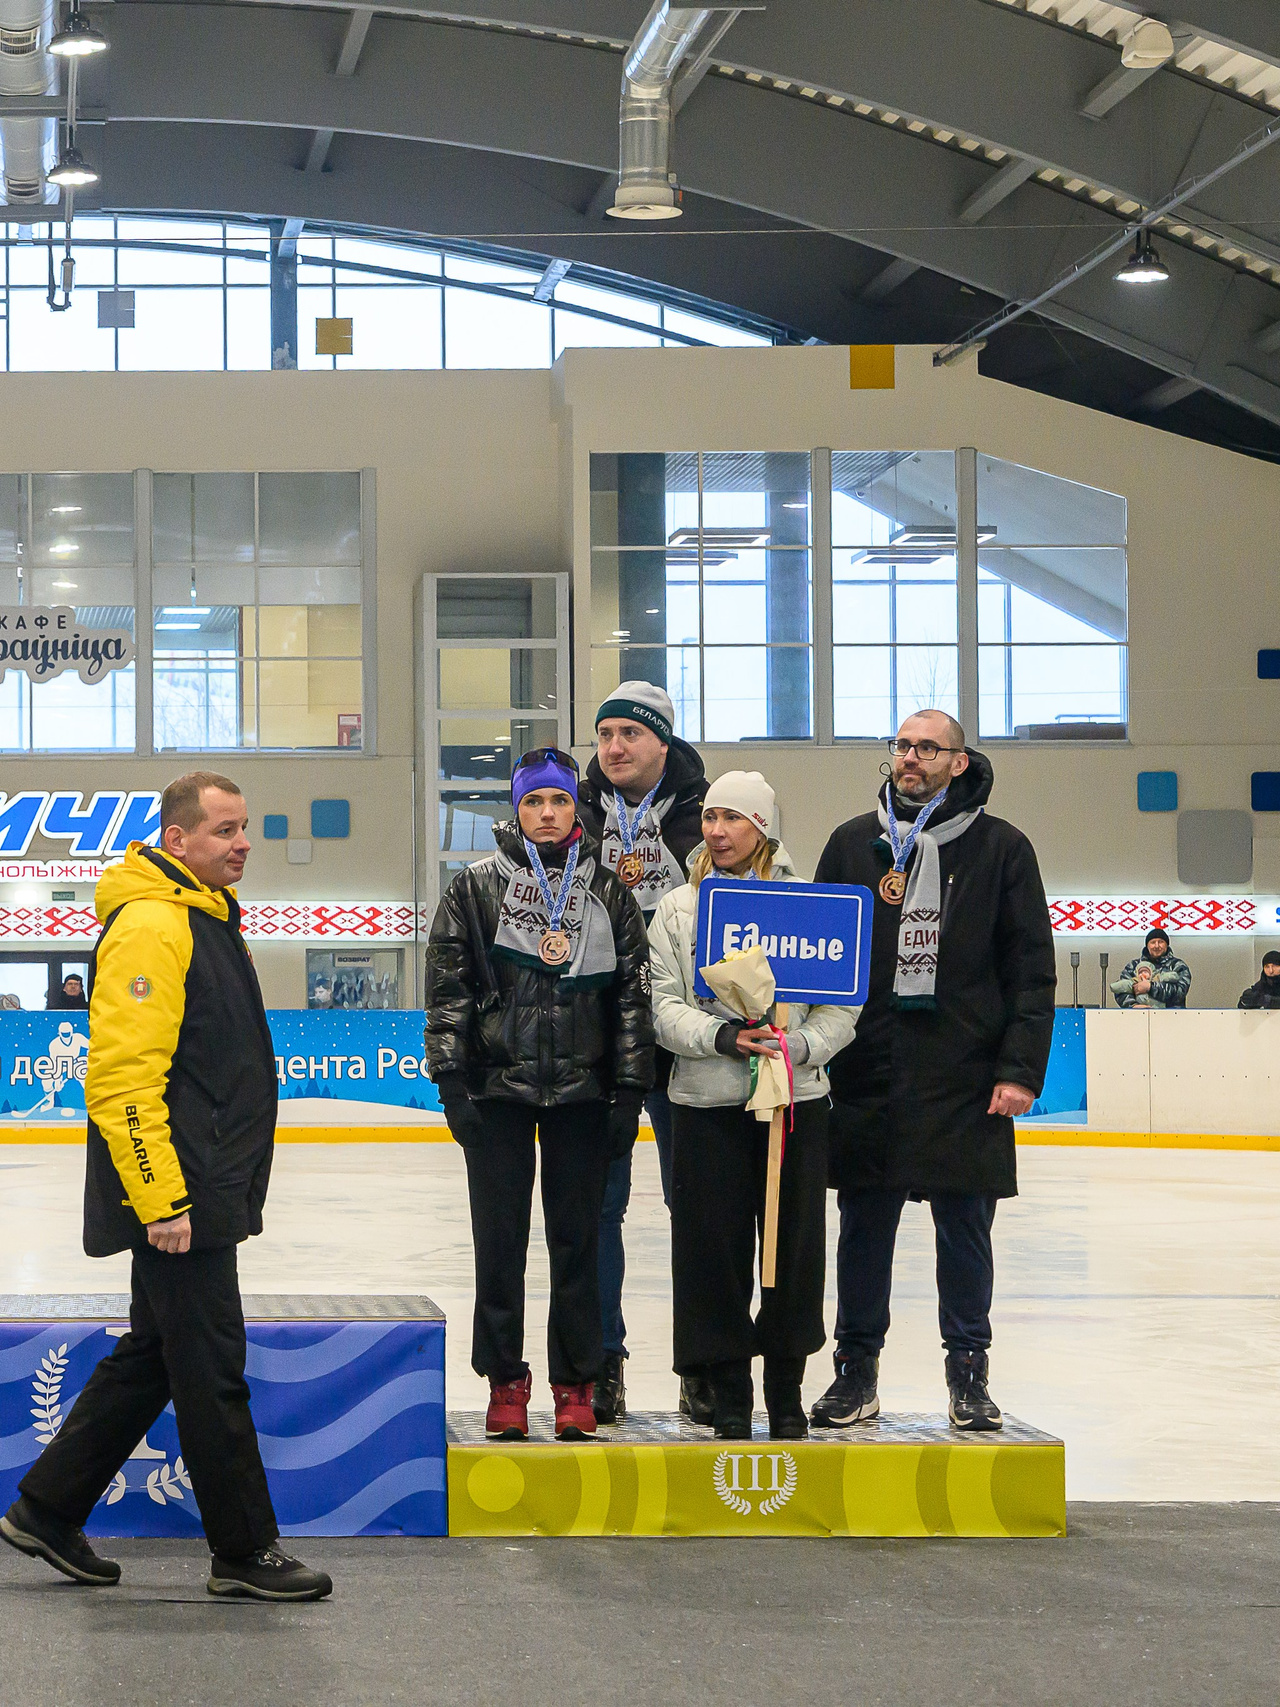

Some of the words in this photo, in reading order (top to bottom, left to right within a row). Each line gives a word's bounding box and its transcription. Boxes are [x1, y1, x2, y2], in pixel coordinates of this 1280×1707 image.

[722, 922, 844, 962] Единые
[904, 929, 940, 949] ЕДИ
[125, 1104, 155, 1185] BELARUS
[726, 1453, 784, 1491] III
